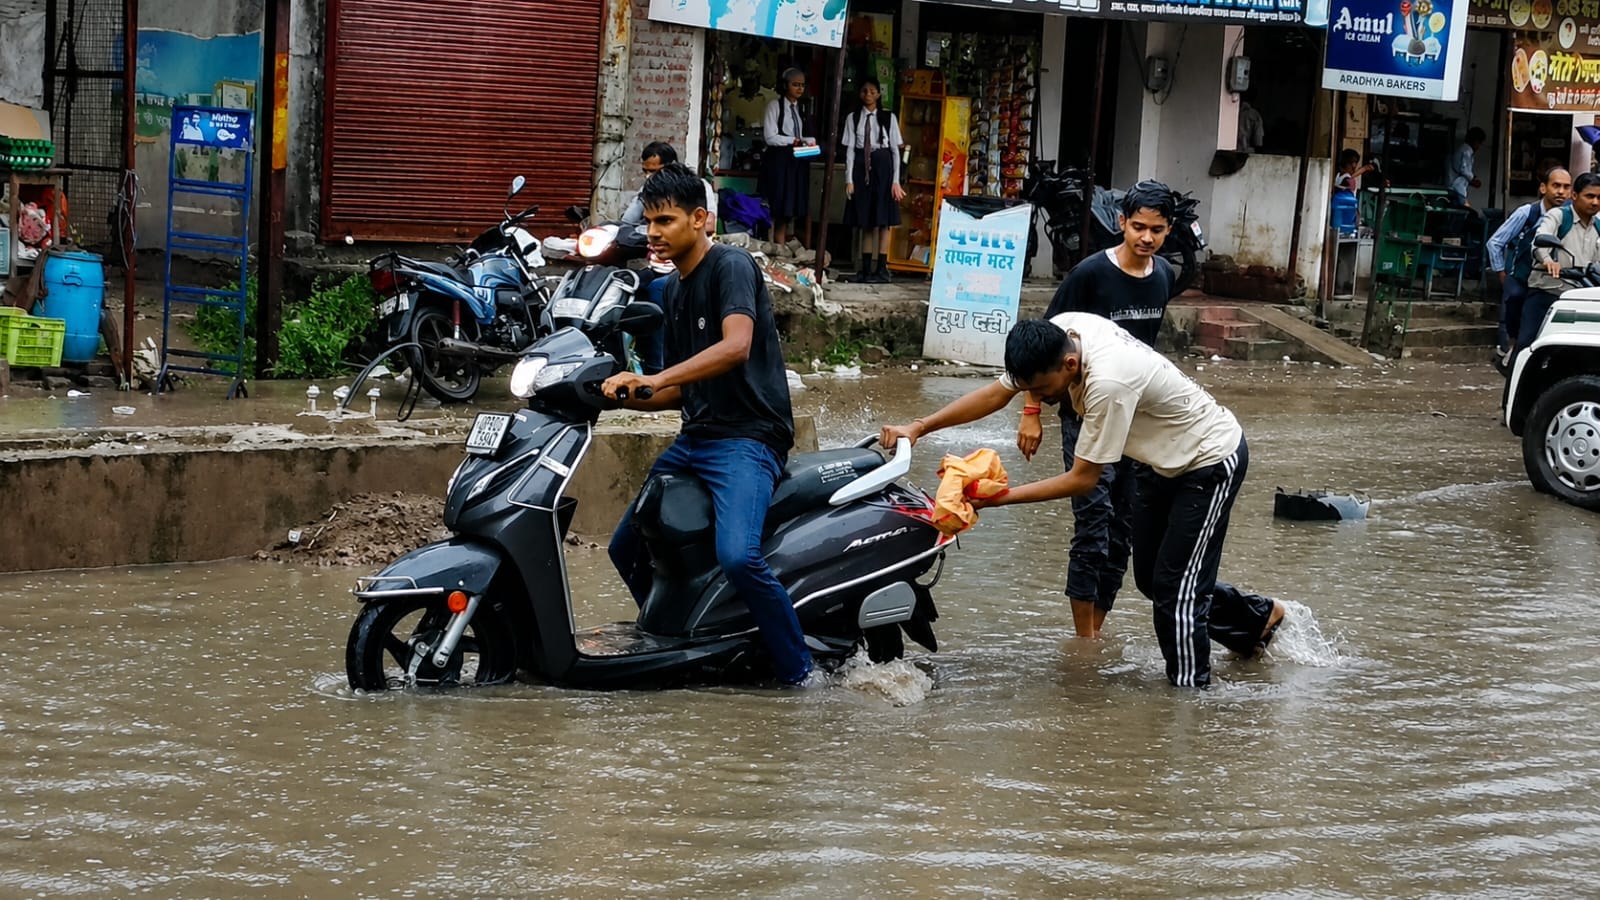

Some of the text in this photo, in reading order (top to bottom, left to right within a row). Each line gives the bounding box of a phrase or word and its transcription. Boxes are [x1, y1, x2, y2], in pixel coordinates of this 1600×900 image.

[1333, 6, 1393, 35] Amul
[1357, 33, 1381, 43] CREAM
[1339, 74, 1426, 91] ARADHYA BAKERS
[987, 253, 1016, 271] मटर
